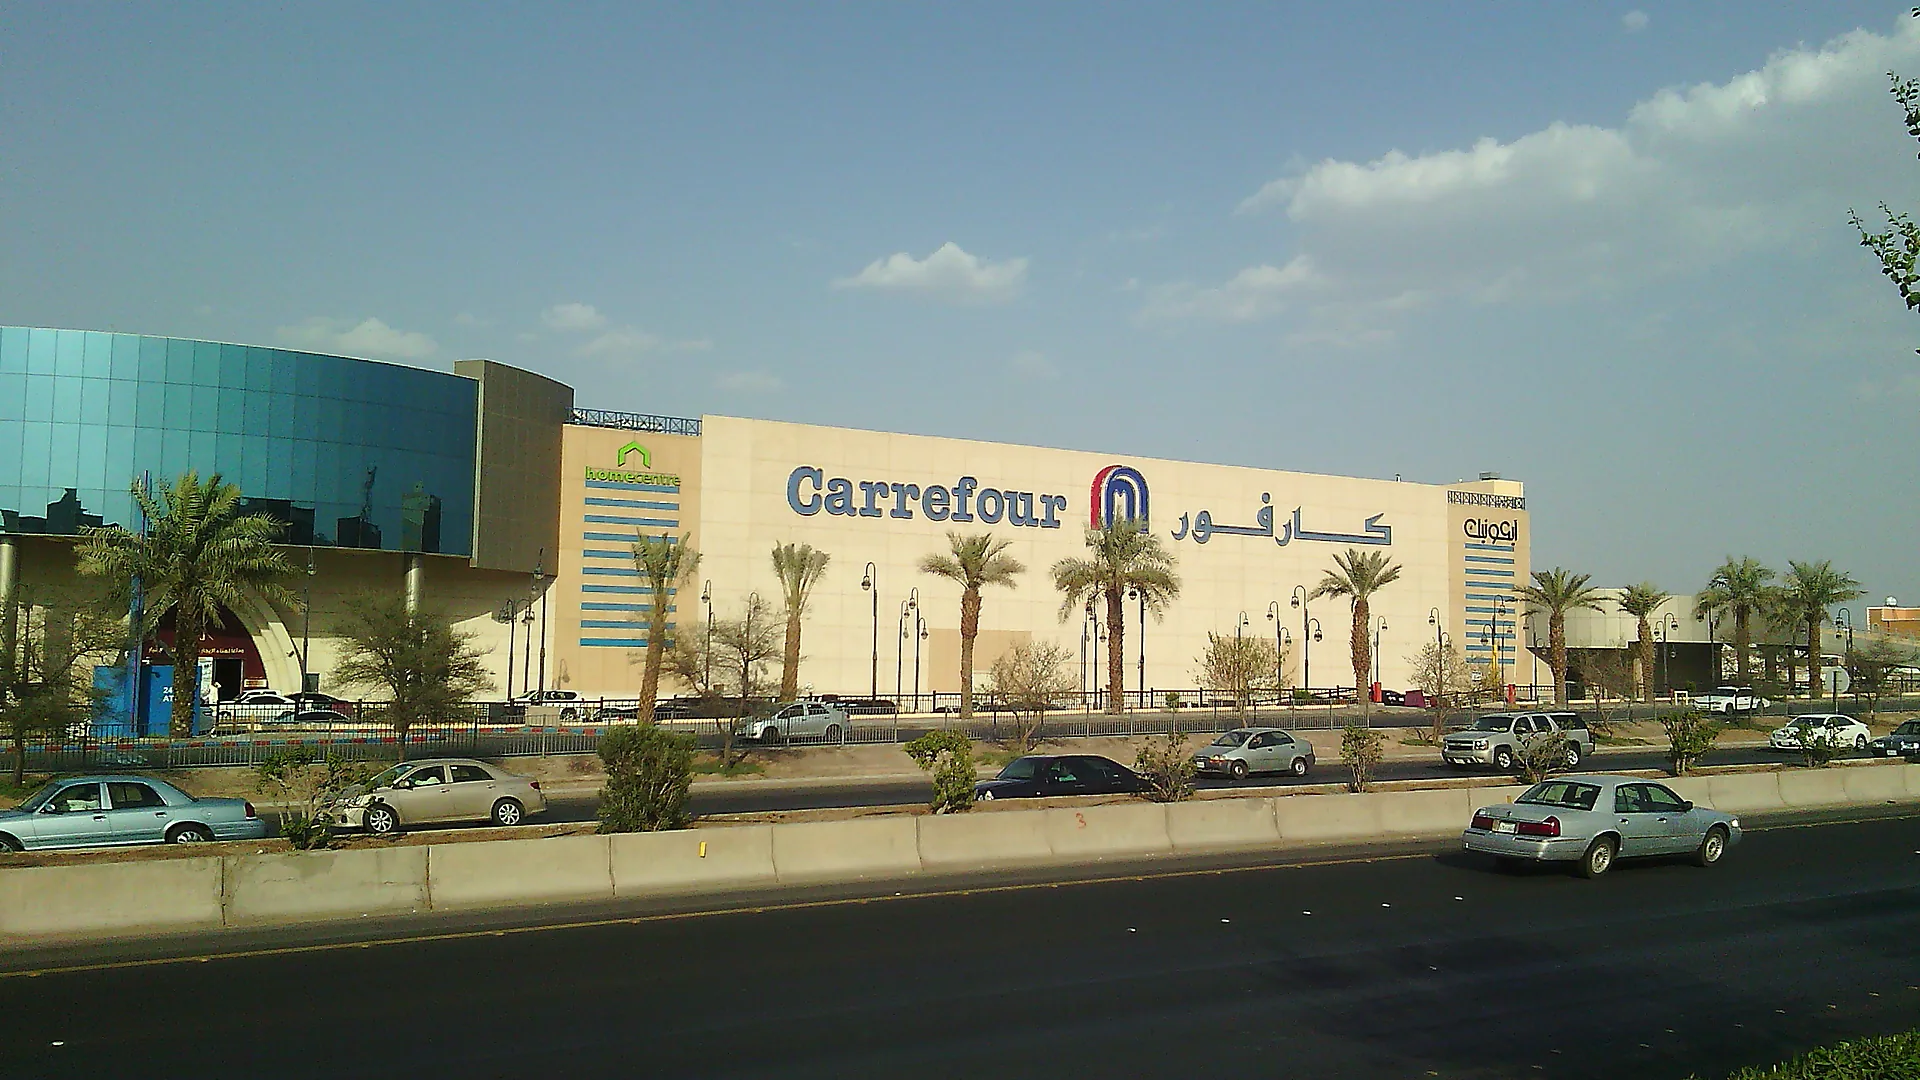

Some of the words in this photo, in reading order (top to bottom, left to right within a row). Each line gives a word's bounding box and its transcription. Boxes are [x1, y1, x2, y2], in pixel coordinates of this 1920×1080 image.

[585, 466, 681, 486] homecentre
[787, 465, 1067, 528] Carrefour
[1171, 492, 1392, 546] كارفور
